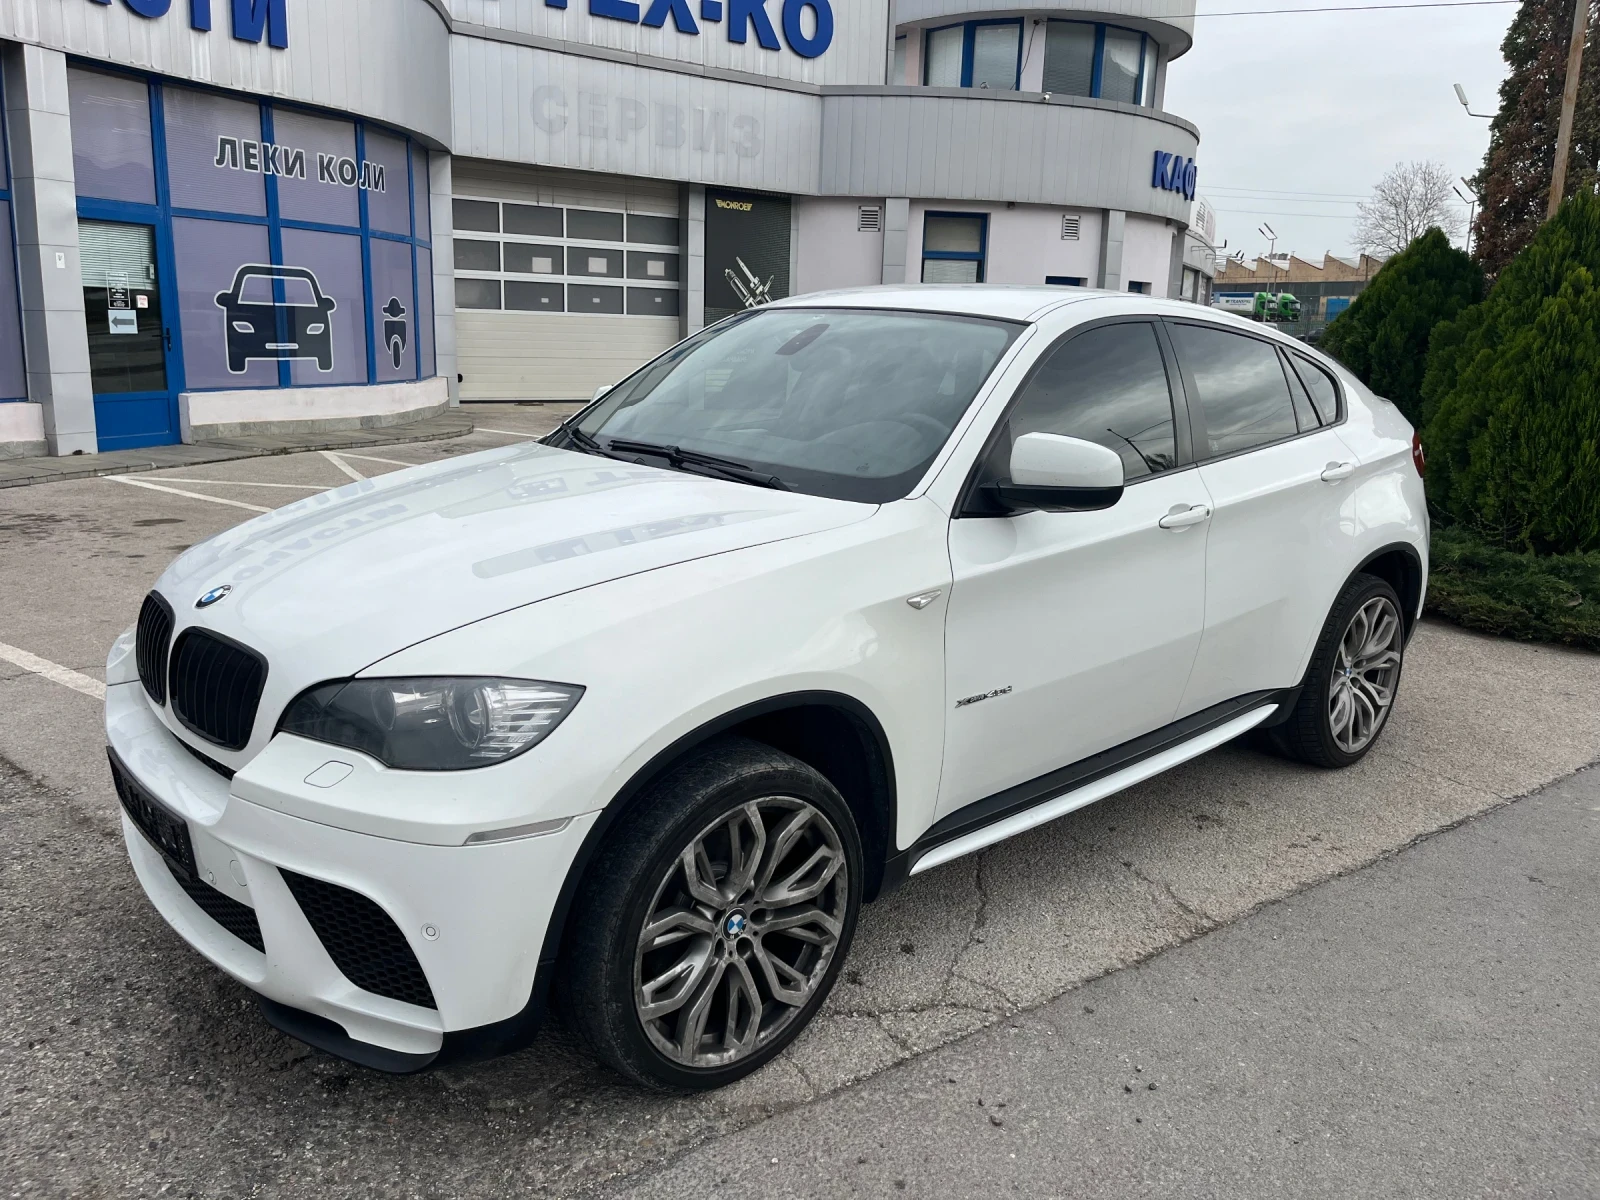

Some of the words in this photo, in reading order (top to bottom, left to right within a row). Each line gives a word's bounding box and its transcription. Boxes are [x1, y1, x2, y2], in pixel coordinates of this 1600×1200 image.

[530, 84, 762, 158] СЕРВИЗ
[214, 135, 307, 180] ЛЕКИ
[316, 152, 386, 193] КОЛИ
[1152, 150, 1197, 201] КАФ
[717, 199, 752, 211] MONROE
